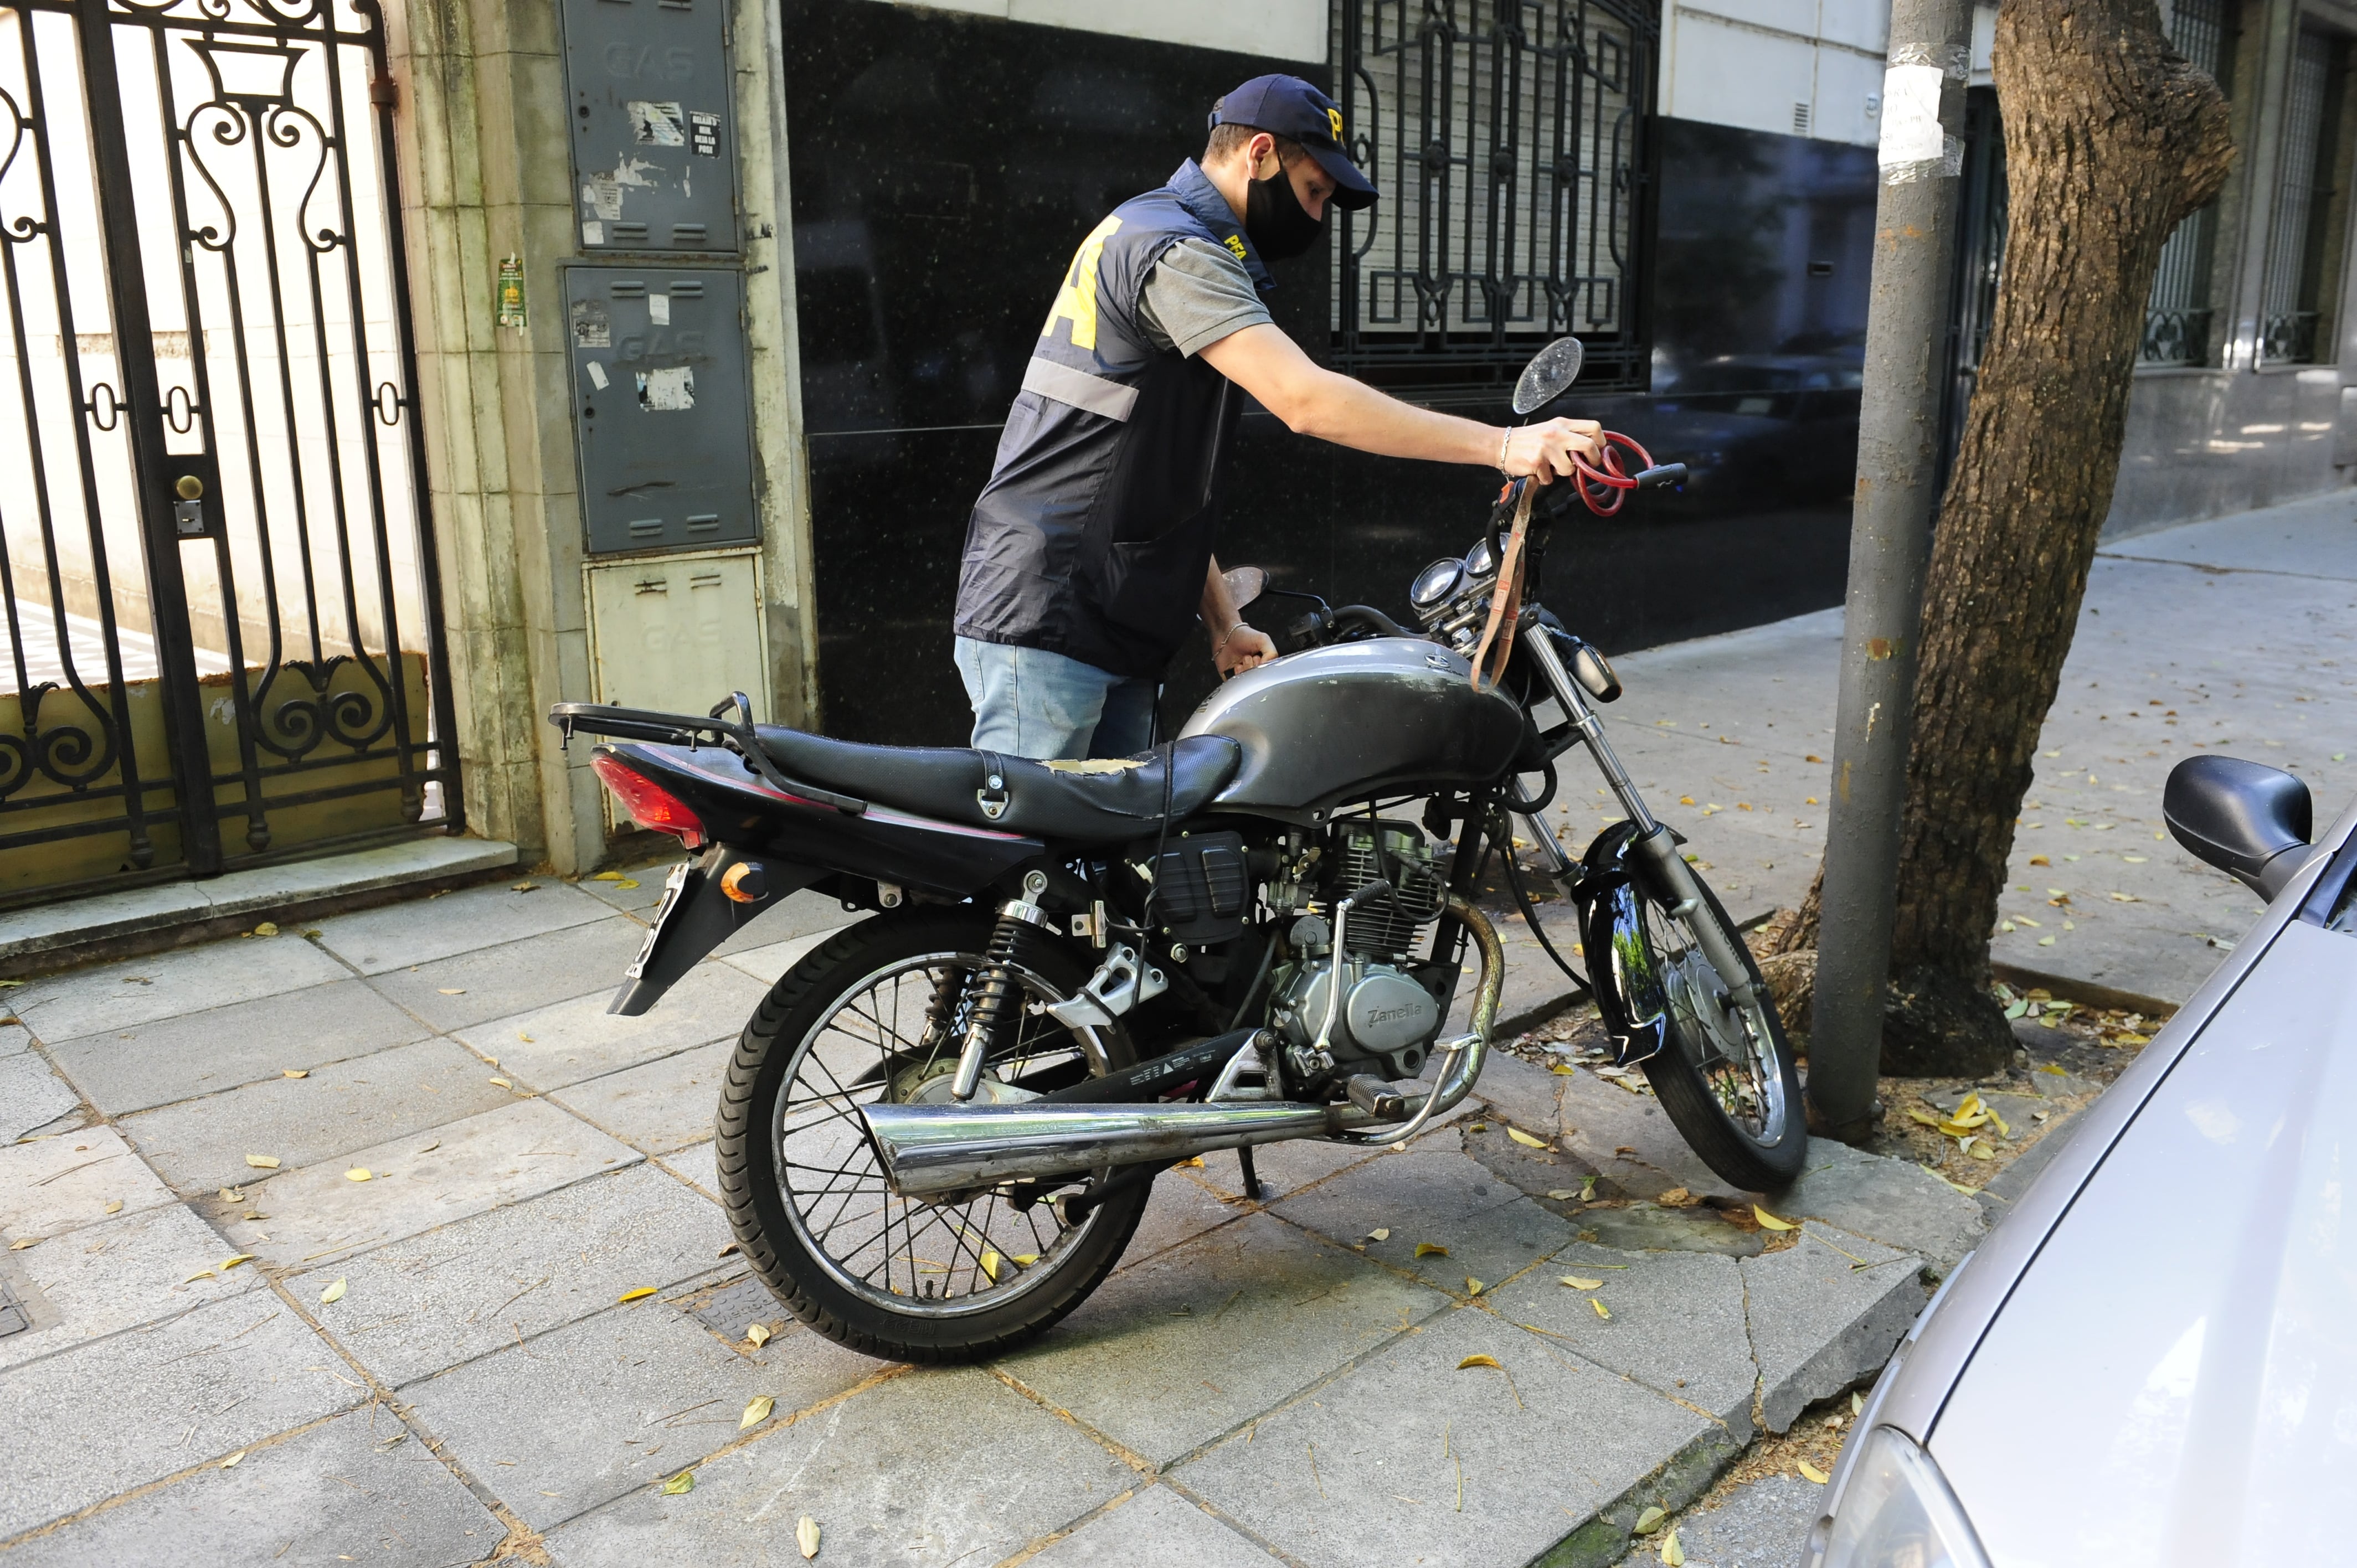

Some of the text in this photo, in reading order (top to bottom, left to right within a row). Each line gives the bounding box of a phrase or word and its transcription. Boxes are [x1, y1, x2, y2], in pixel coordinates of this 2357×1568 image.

[604, 40, 694, 81] GAS
[1327, 108, 1344, 147] P
[1224, 234, 1247, 260] PFA
[617, 331, 707, 361] GAS
[1367, 1003, 1422, 1028] Zanella
